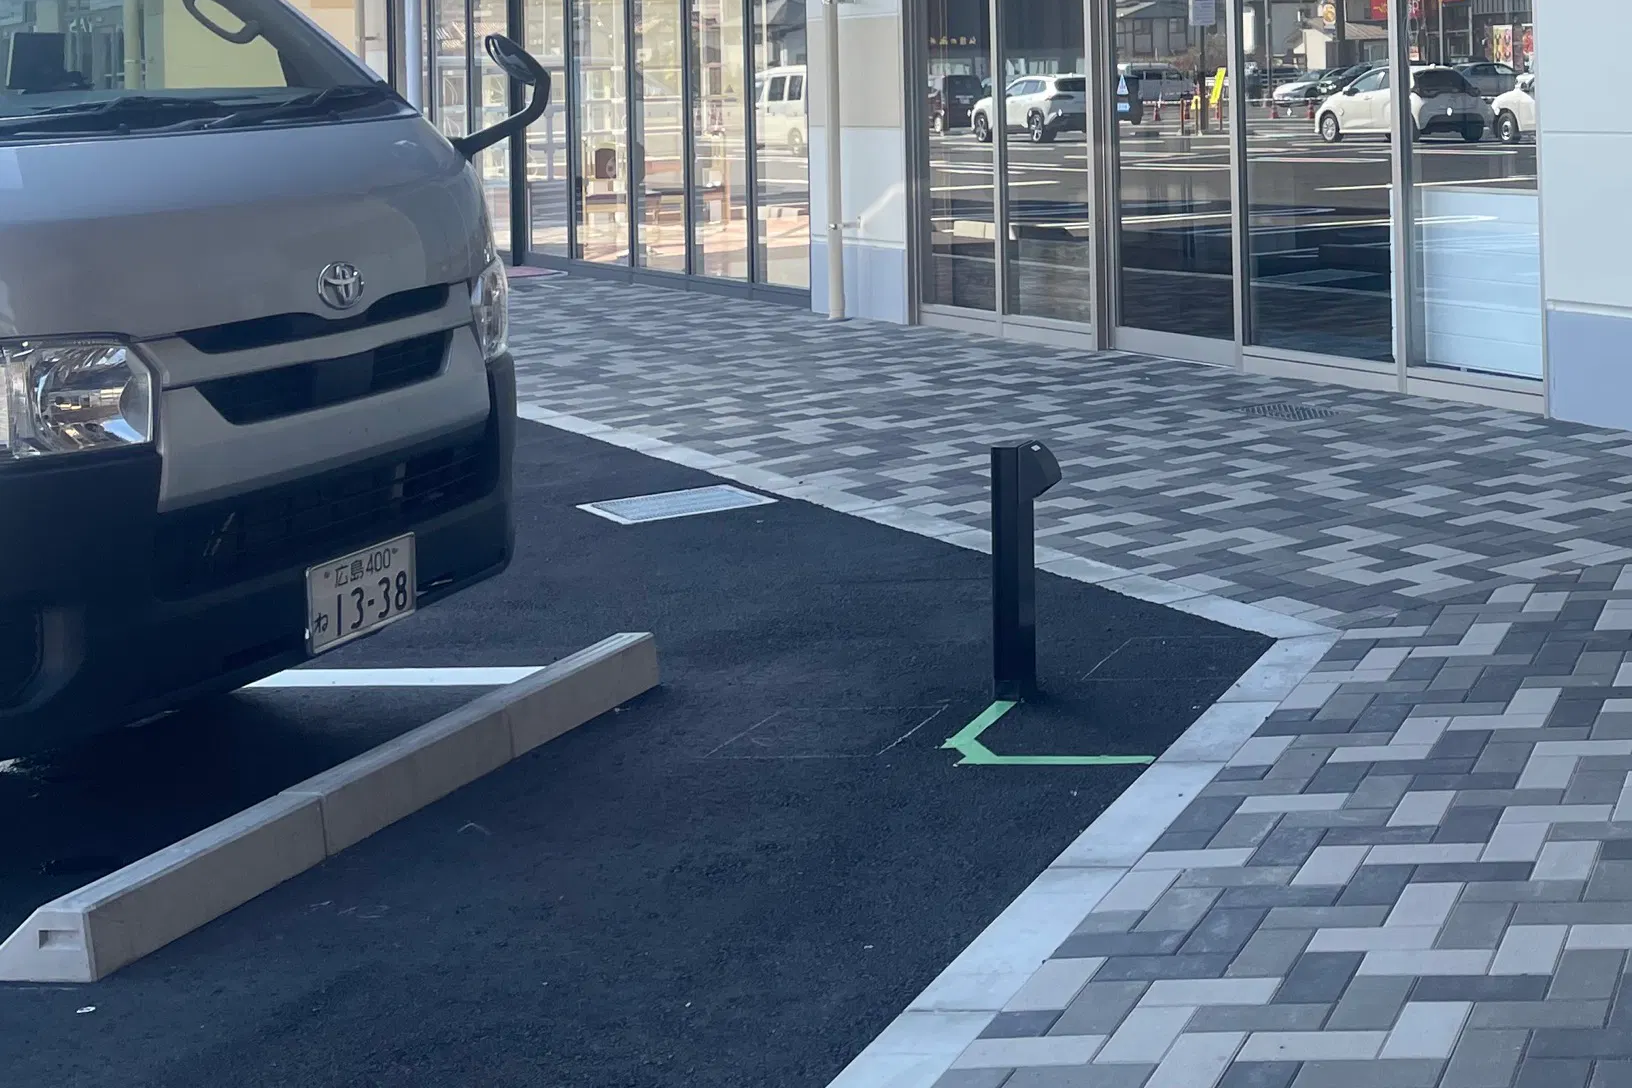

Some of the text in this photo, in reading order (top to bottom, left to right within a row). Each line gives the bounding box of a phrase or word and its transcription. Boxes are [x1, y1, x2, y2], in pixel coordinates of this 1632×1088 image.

[335, 548, 391, 588] 広島400
[314, 570, 408, 636] ね 13-38
